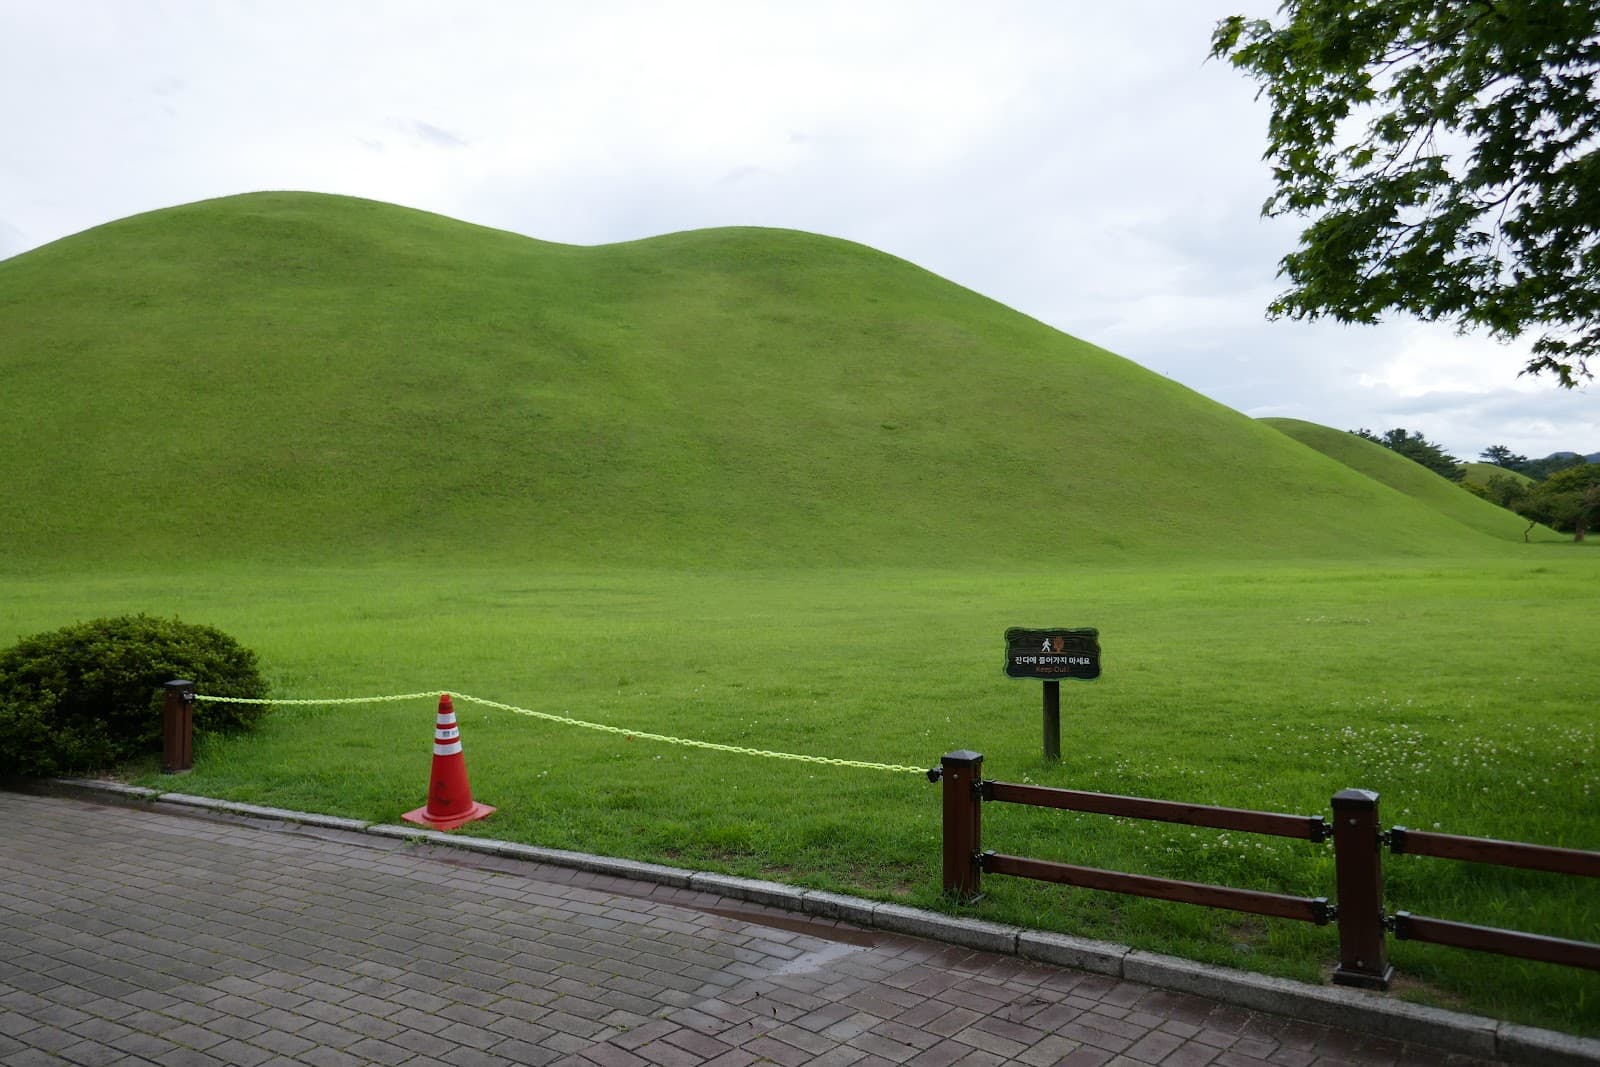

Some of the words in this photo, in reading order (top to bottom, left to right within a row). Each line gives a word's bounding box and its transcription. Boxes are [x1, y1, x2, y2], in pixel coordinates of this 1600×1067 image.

[1015, 656, 1037, 665] 잔디에
[1038, 656, 1067, 665] 들어가지
[1069, 656, 1091, 665] 마세요
